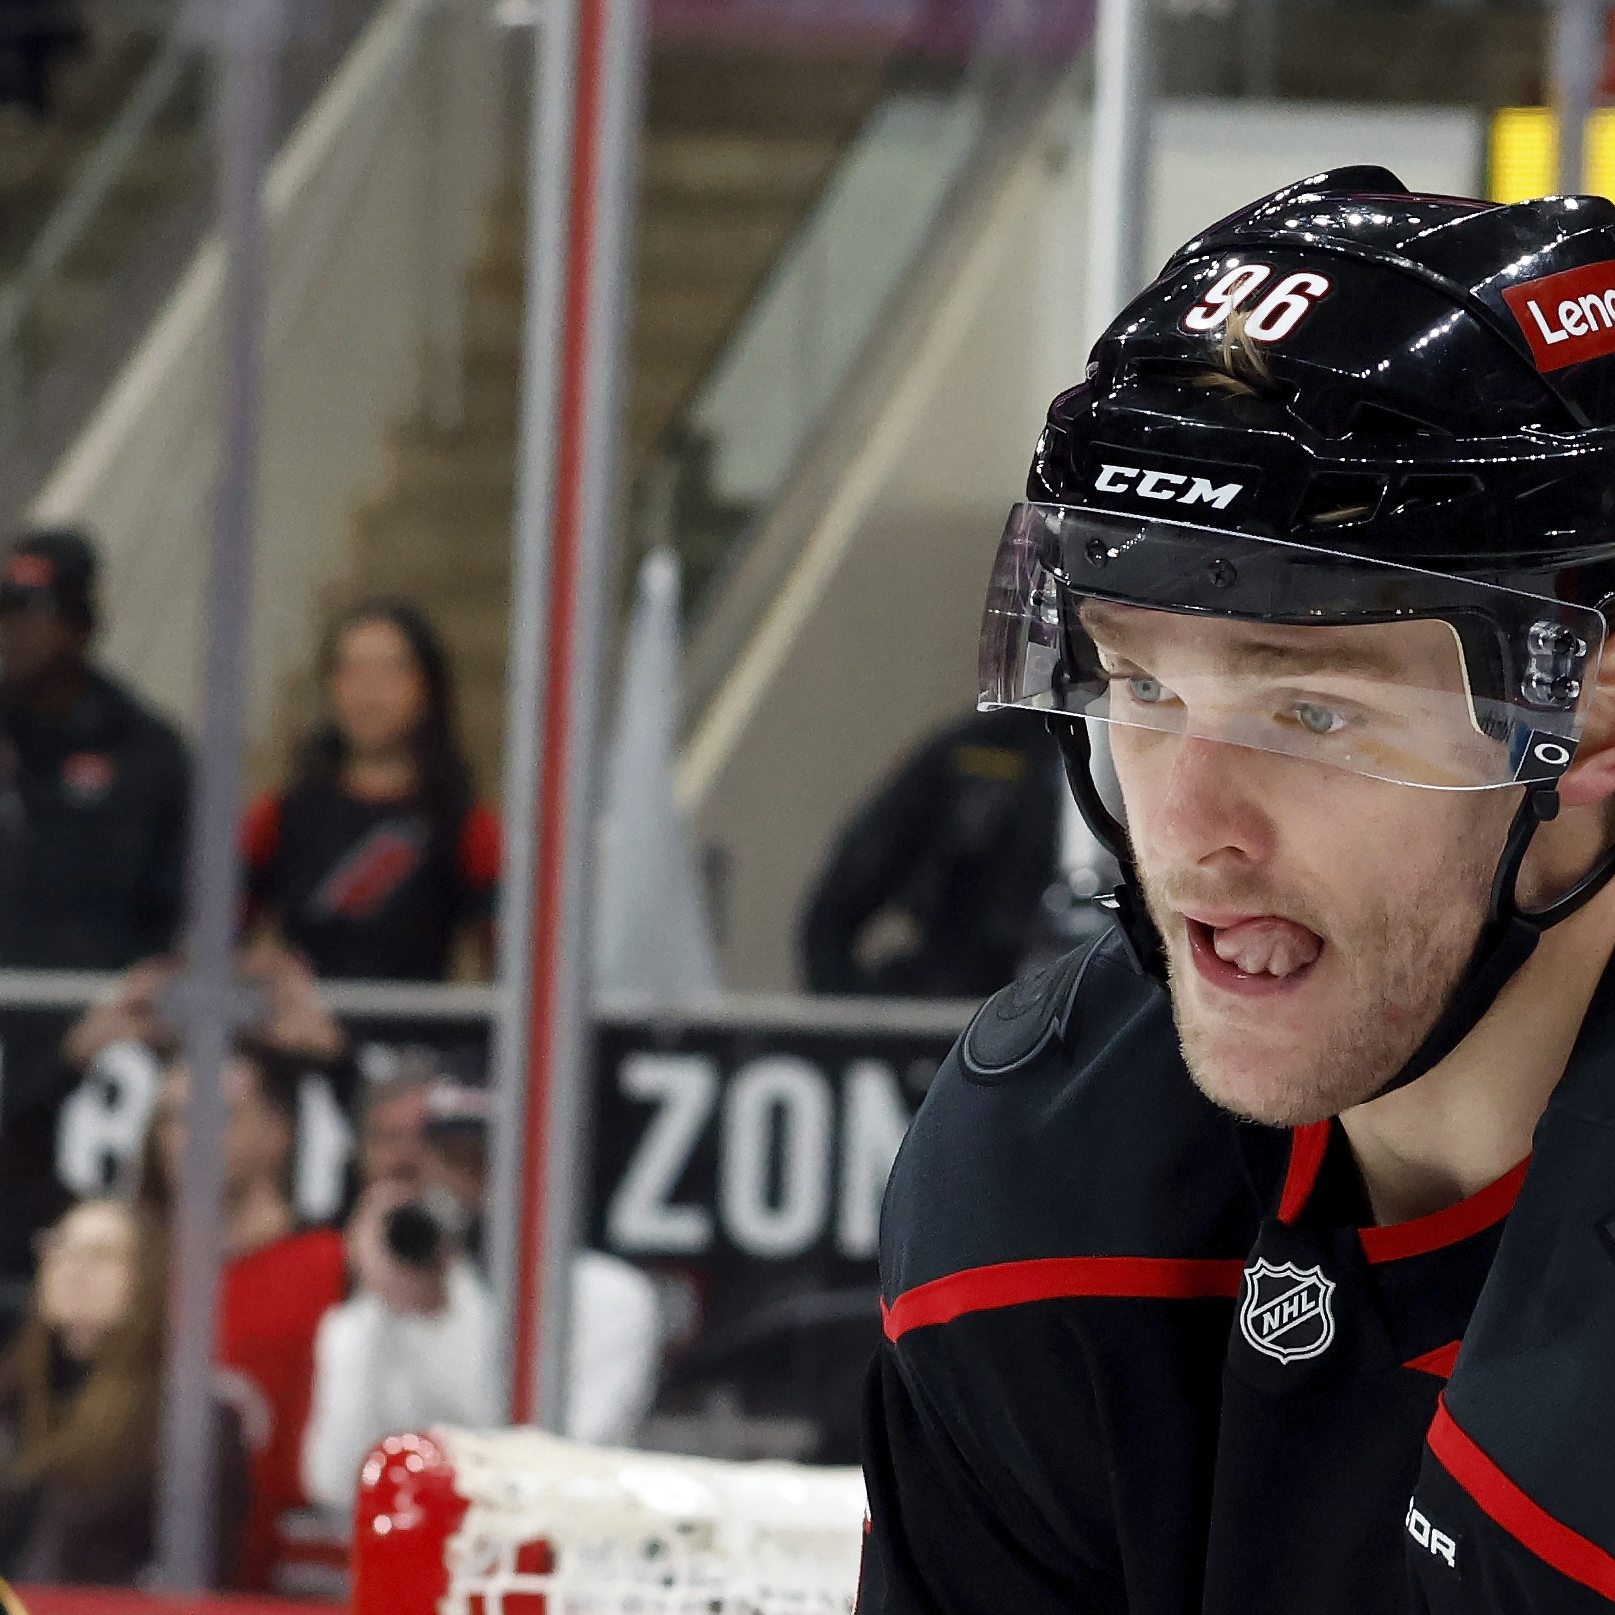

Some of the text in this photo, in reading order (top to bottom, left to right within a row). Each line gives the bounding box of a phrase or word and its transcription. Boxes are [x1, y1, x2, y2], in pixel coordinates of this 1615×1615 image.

[1183, 261, 1334, 344] 96
[1095, 464, 1244, 510] CCM
[1262, 1289, 1316, 1336] NHL
[1405, 1495, 1457, 1568] OR
